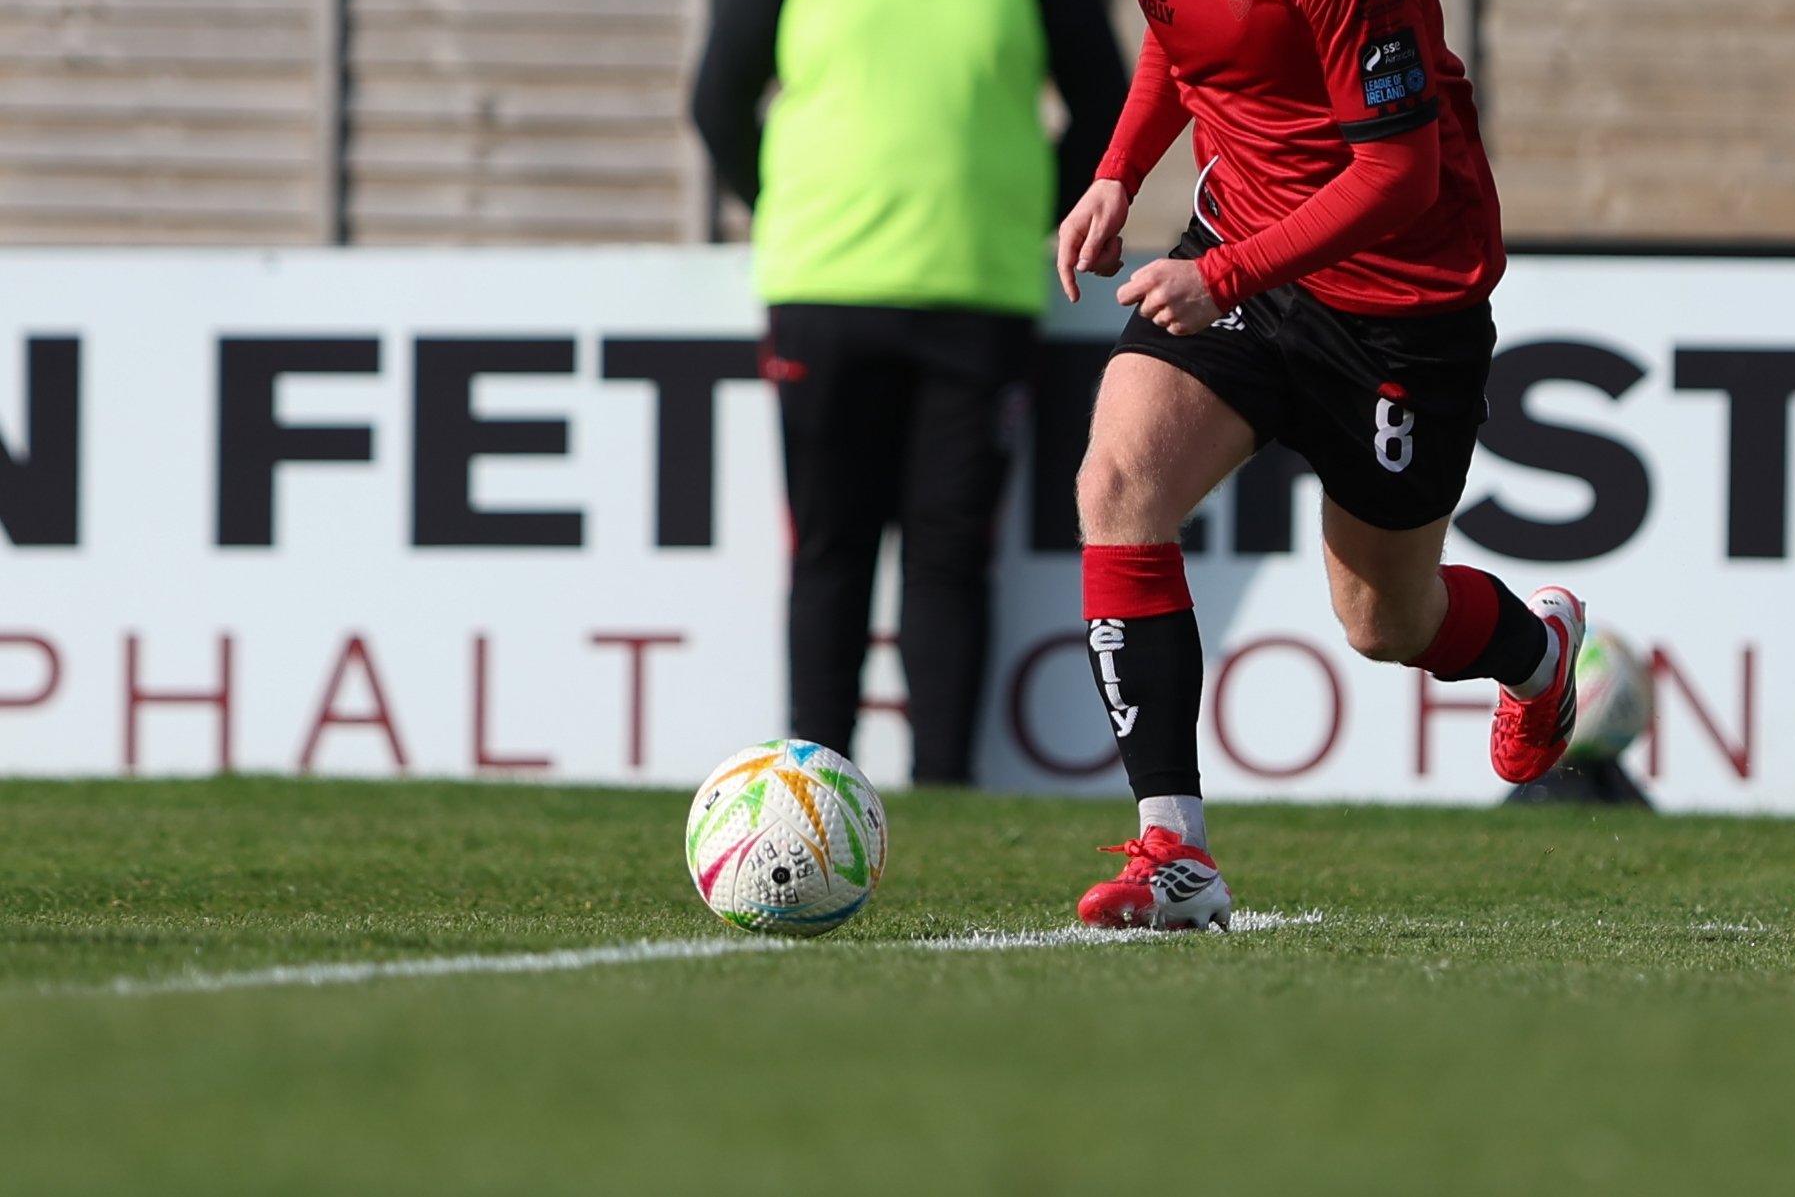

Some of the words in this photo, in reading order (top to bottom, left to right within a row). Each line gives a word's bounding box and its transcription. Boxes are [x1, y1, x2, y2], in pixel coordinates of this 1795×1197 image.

[1383, 40, 1401, 54] sse
[1365, 75, 1392, 93] LEAGUE
[1366, 84, 1405, 106] IRELAND
[1374, 397, 1415, 473] 8
